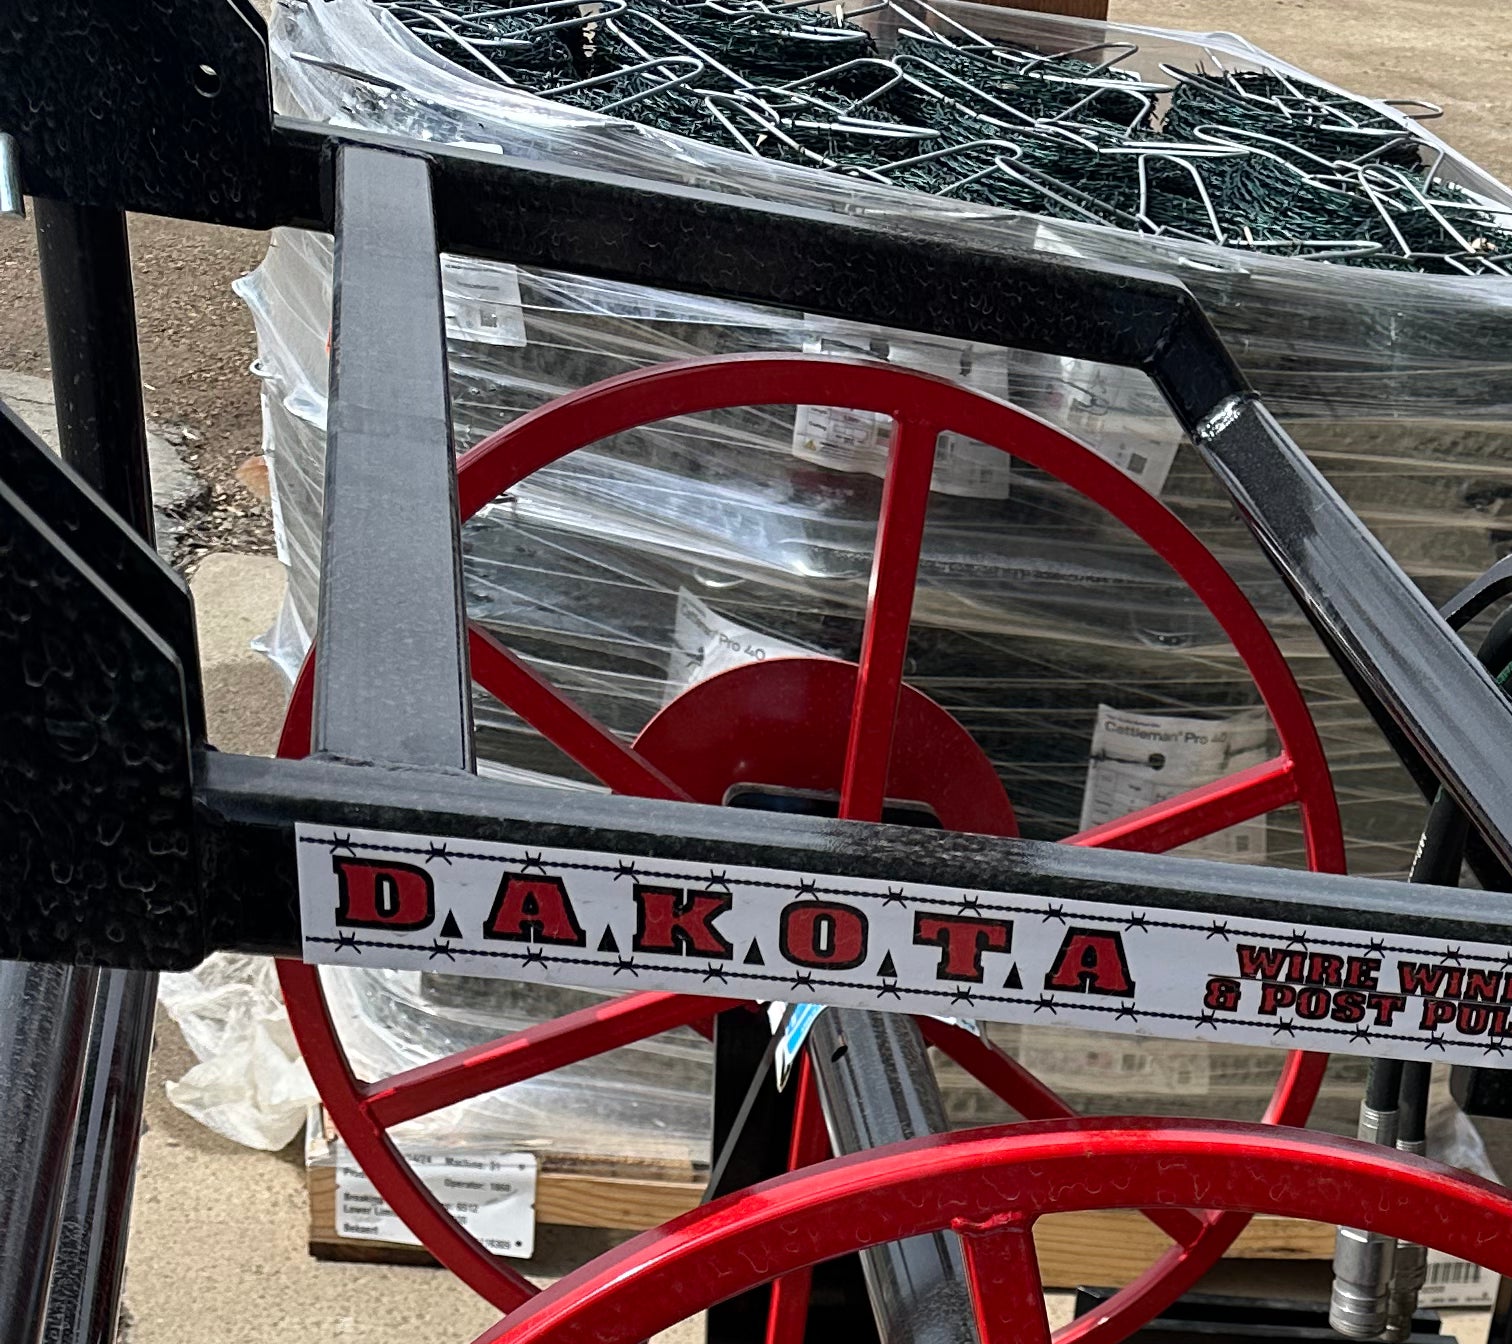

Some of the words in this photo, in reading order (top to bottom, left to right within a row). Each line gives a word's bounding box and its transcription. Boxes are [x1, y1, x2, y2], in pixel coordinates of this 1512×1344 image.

[1183, 731, 1209, 746] Pro
[1235, 943, 1381, 991] WIRE
[1203, 977, 1240, 1013] &
[1257, 982, 1408, 1027] POST
